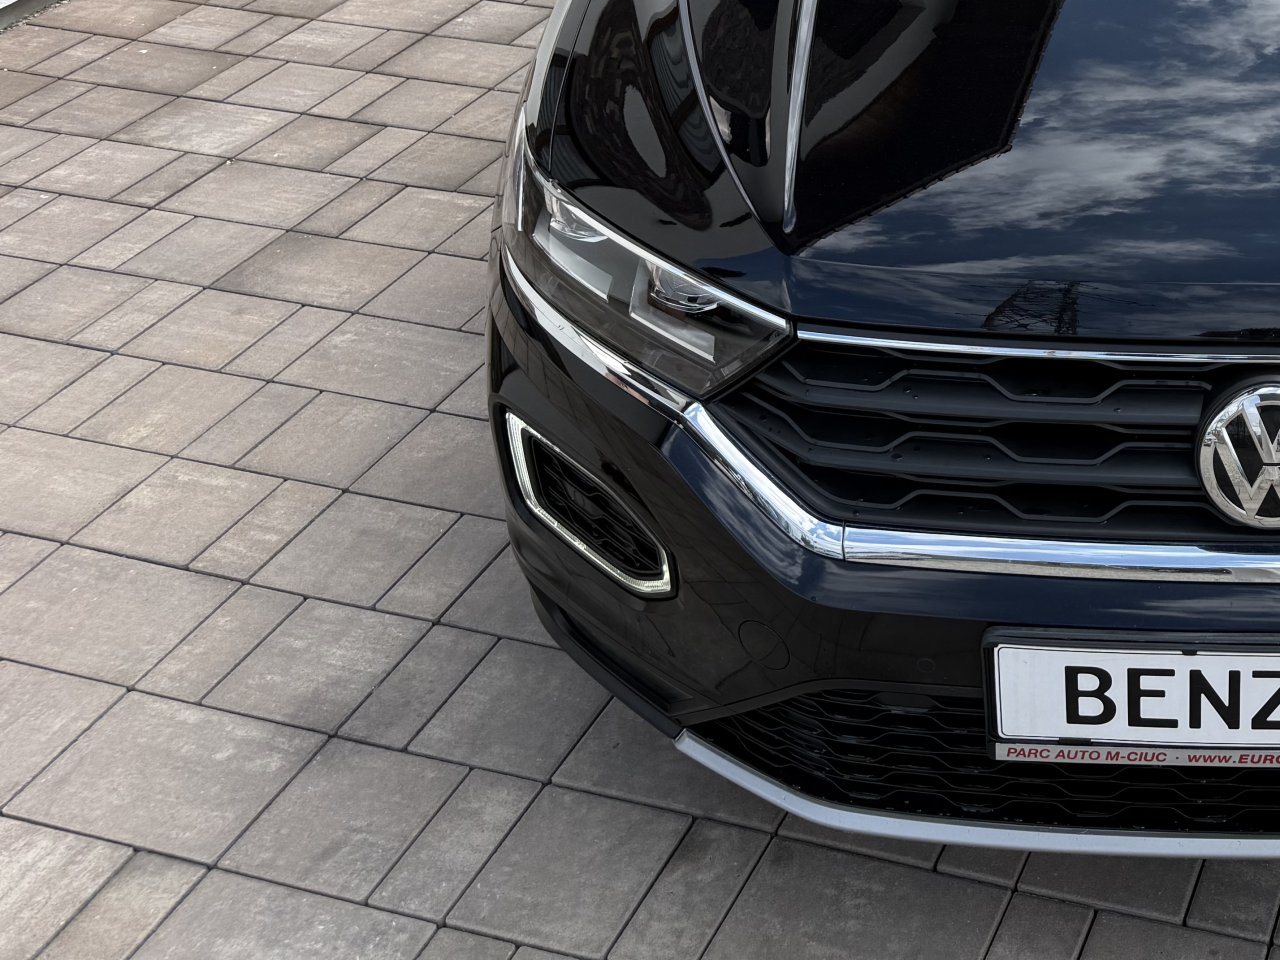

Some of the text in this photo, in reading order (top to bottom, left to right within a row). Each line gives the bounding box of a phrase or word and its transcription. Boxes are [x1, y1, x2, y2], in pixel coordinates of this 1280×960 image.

[1006, 747, 1051, 759] PARC
[1055, 749, 1101, 761] AUTO
[1105, 751, 1167, 763] M-CIUC
